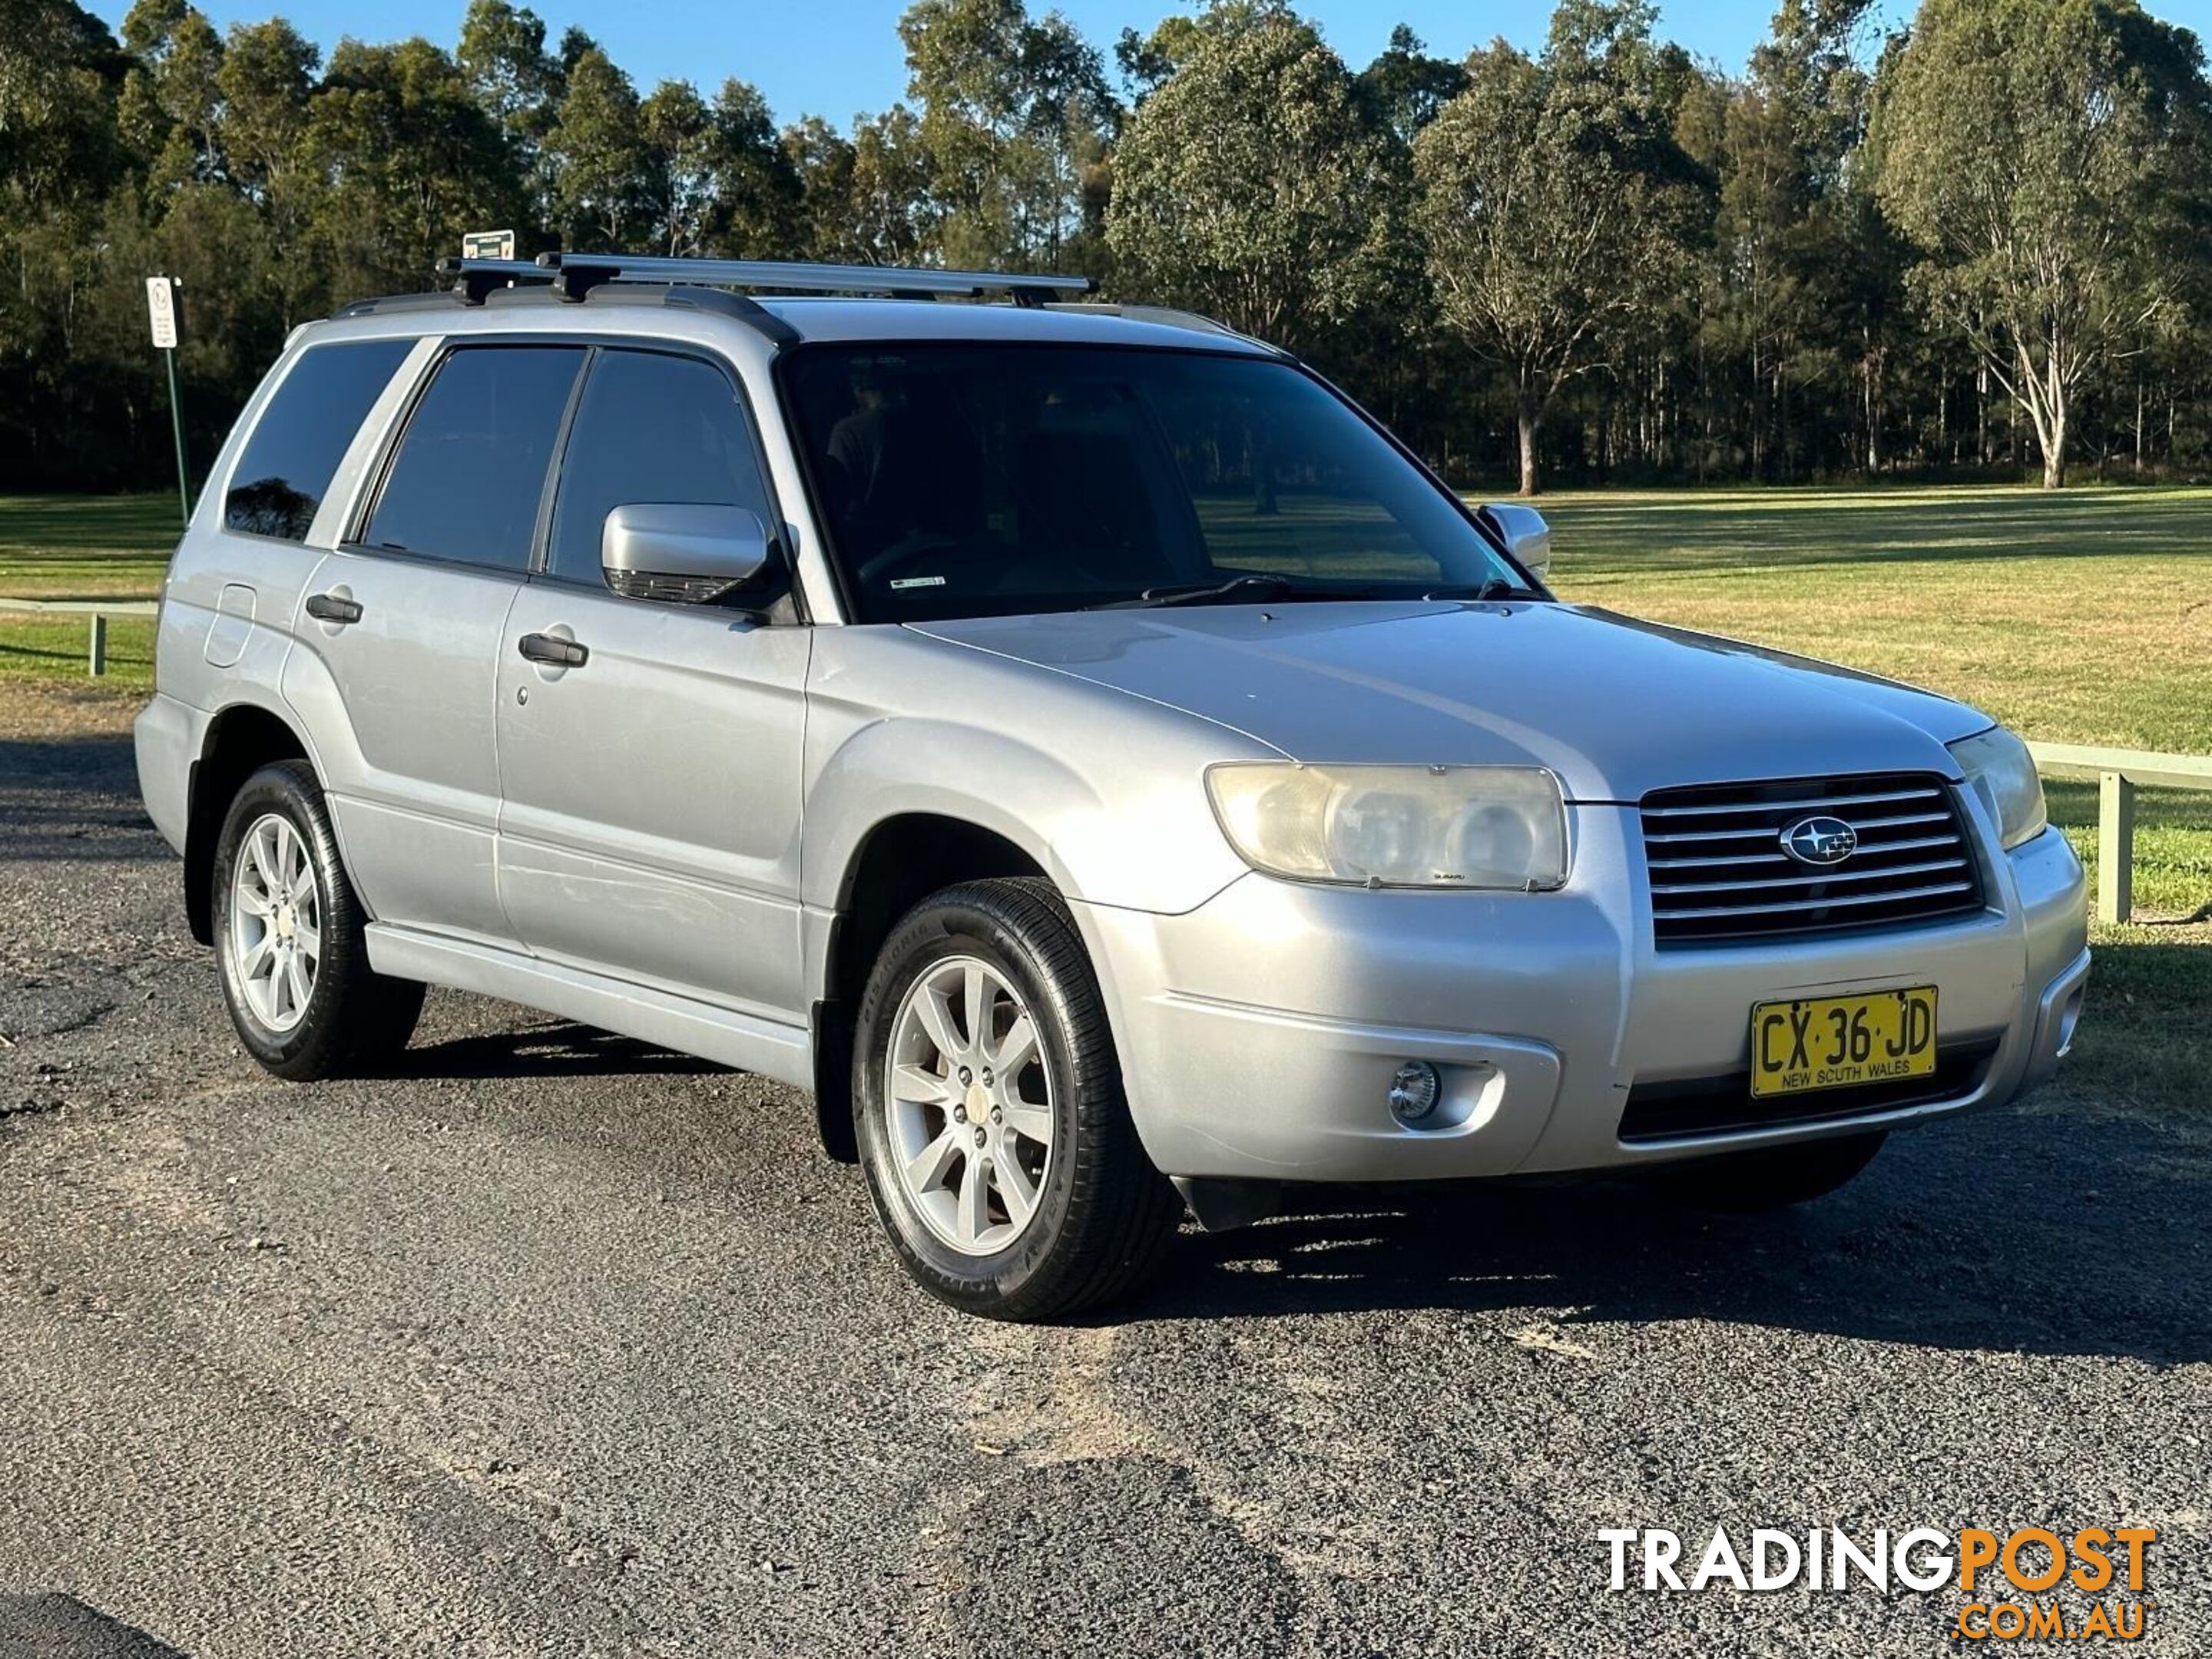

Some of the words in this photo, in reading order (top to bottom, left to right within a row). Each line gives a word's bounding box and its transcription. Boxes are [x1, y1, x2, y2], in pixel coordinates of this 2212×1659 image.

[1782, 1073, 1810, 1088] NEW
[1817, 1067, 1862, 1084] SOUTH
[1869, 1060, 1910, 1078] WALES
